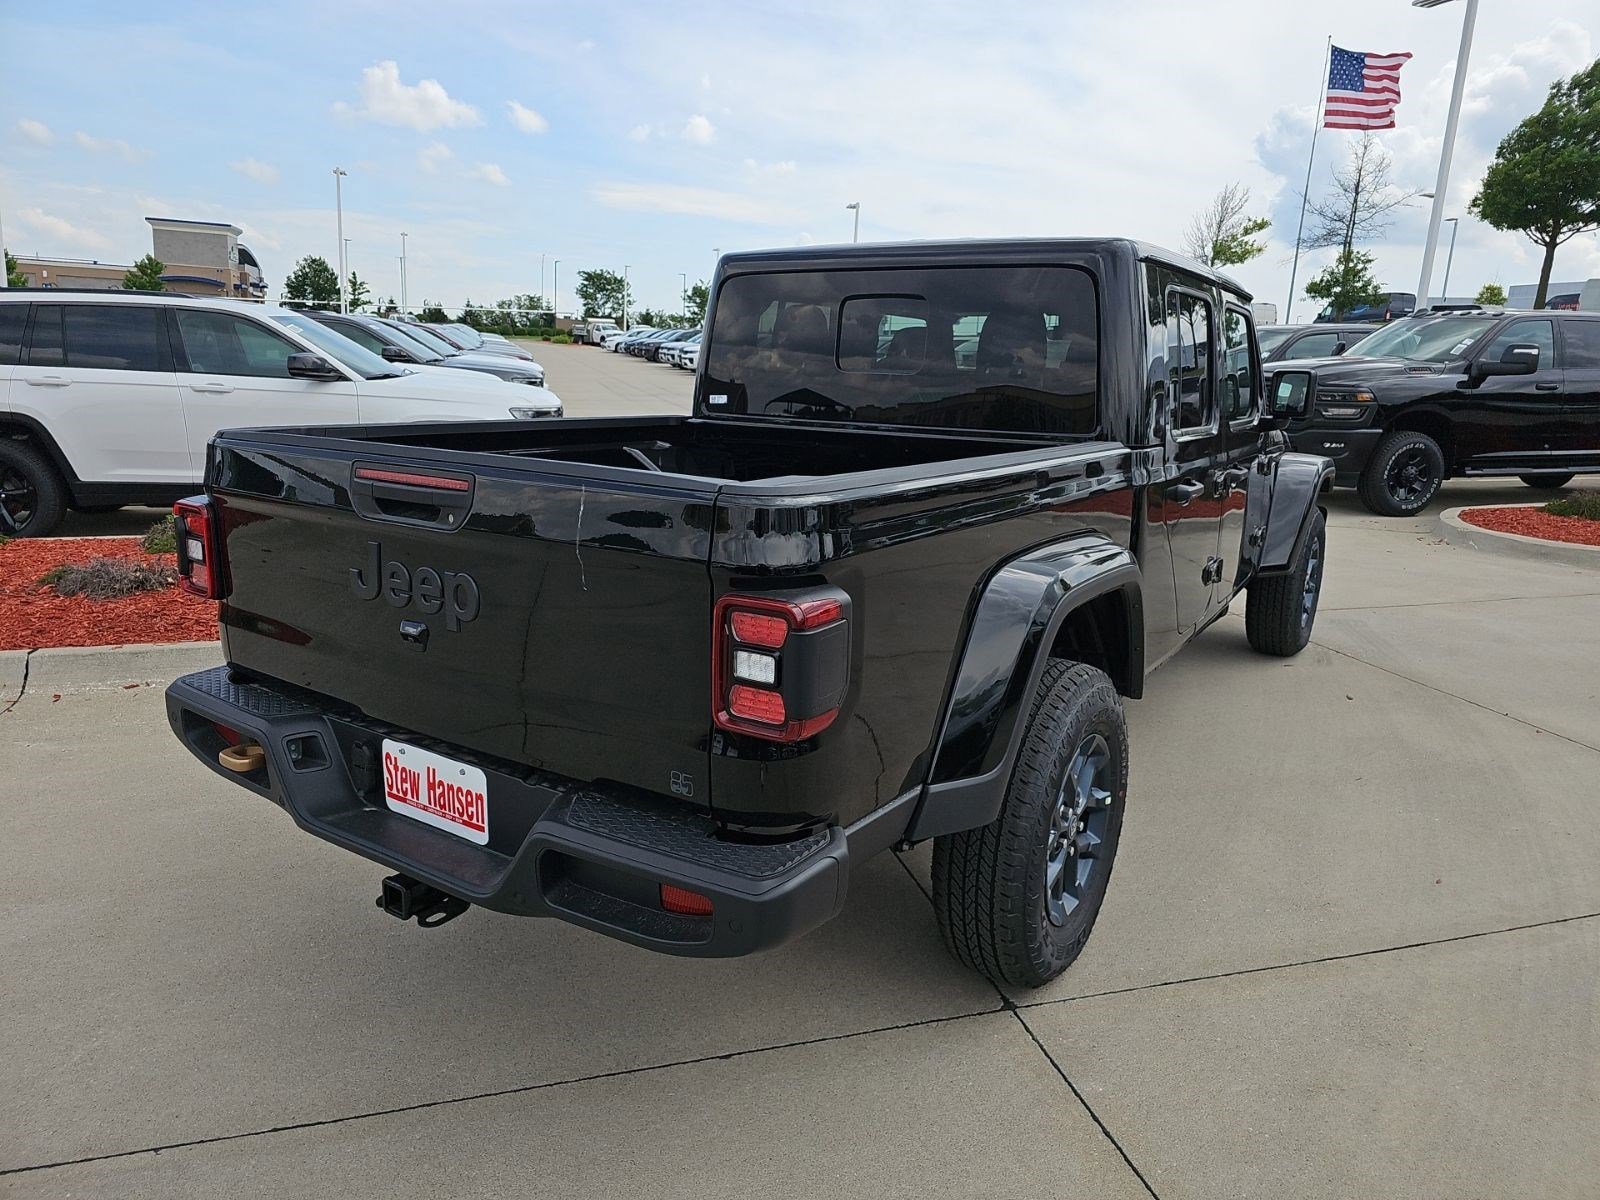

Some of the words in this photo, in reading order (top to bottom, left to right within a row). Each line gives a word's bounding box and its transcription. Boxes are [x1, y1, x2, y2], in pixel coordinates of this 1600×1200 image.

[350, 540, 480, 632] Jeep
[384, 751, 420, 802] Stew
[426, 766, 485, 825] Hansen
